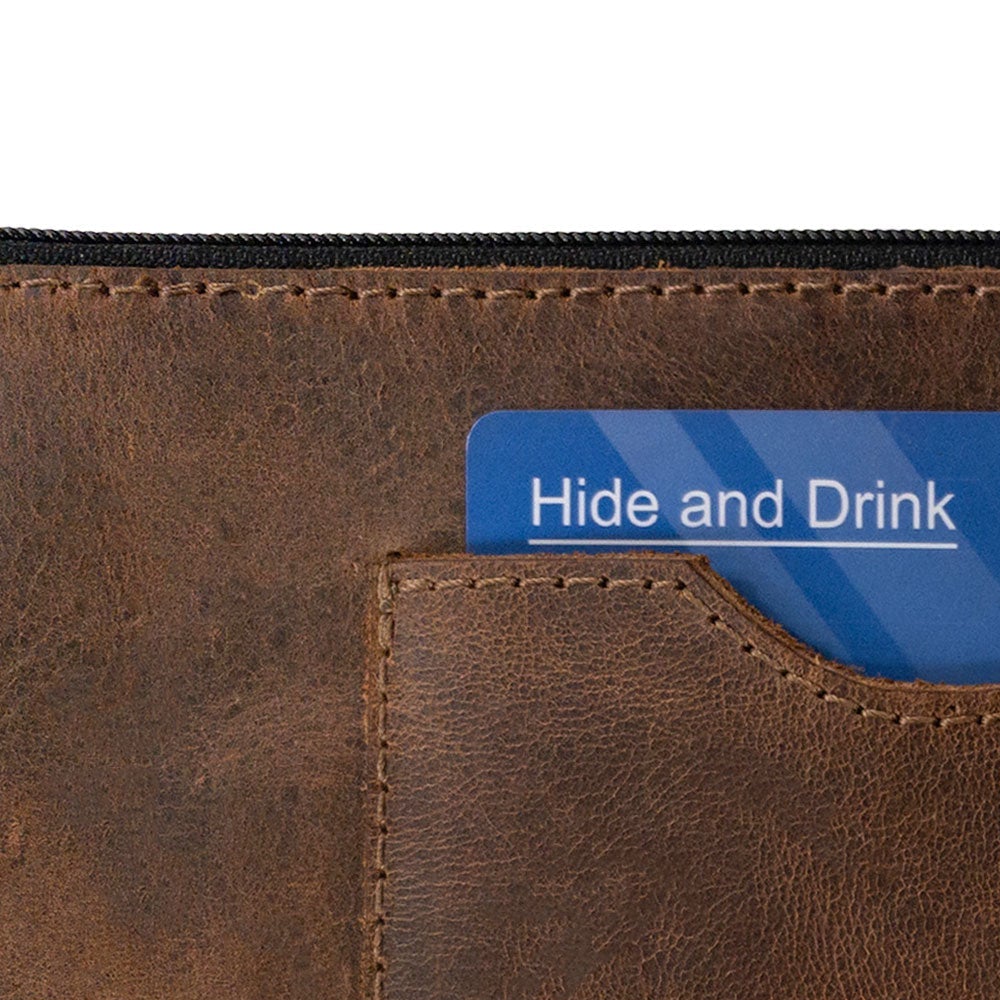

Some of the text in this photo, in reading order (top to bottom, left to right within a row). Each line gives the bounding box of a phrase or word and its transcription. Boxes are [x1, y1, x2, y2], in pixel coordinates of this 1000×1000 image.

[531, 476, 956, 530] Hide and Drink
